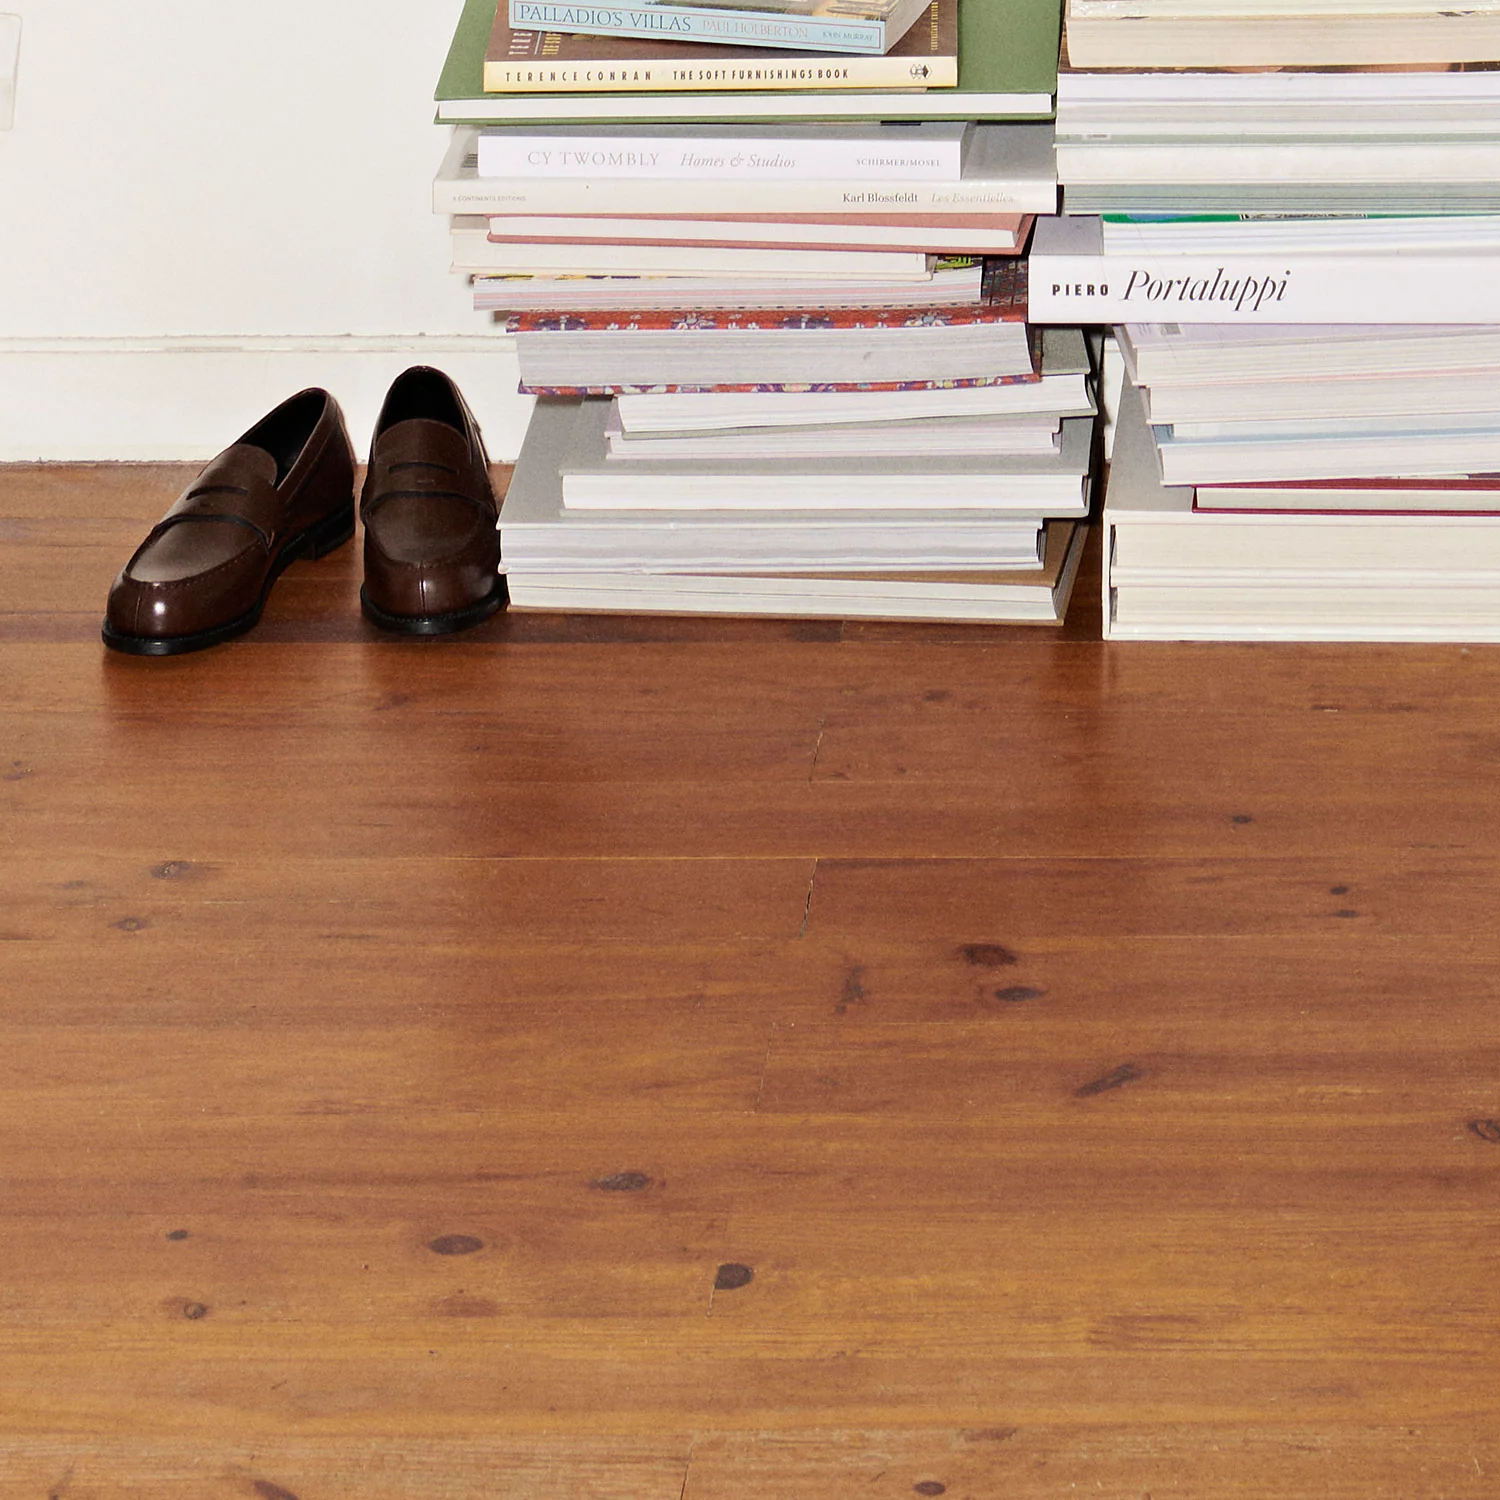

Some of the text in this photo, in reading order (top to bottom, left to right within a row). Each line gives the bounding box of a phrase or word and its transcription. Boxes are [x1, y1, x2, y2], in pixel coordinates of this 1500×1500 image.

[520, 4, 624, 27] PALLADIO'S
[629, 12, 692, 32] VILLAS
[701, 18, 732, 34] PAUL
[734, 22, 809, 39] HOLBERTON
[843, 32, 874, 42] MURRAY
[506, 68, 849, 82] TERENCE CONRAN THE SOFT FURNISHINGS BOOK
[527, 151, 940, 168] CY TWOMBLY Homes & Studios SCHIRMER/MOSEL
[843, 193, 864, 203] Karl
[868, 192, 918, 203] Blossfeldt
[931, 193, 949, 203] Les
[1052, 267, 1292, 312] PIERO Portaluppi
